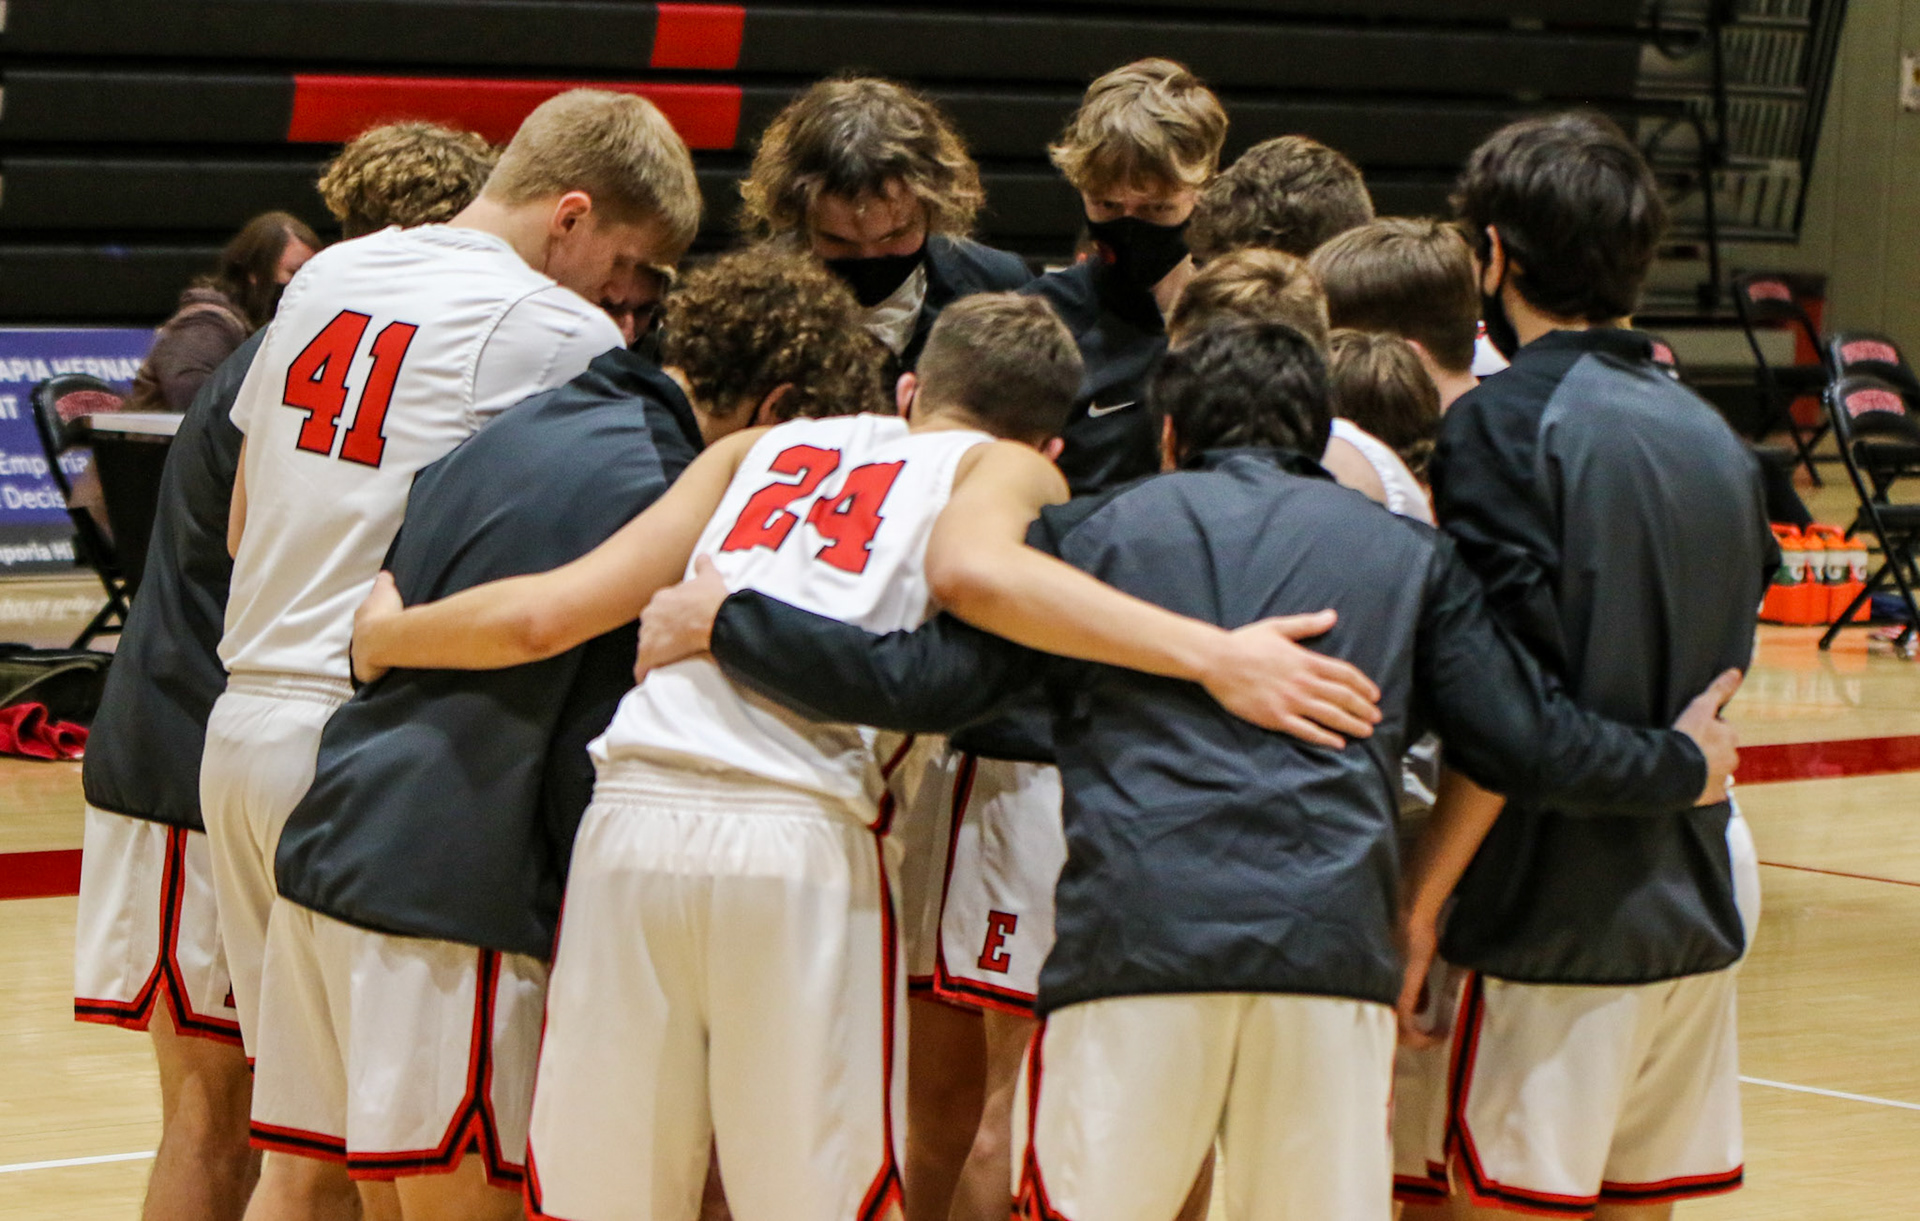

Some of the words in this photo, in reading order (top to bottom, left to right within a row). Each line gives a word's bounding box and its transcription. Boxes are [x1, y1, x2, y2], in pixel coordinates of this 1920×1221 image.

[282, 308, 420, 470] 41
[0, 451, 89, 479] Empria
[719, 444, 907, 576] 24
[978, 910, 1017, 975] E
